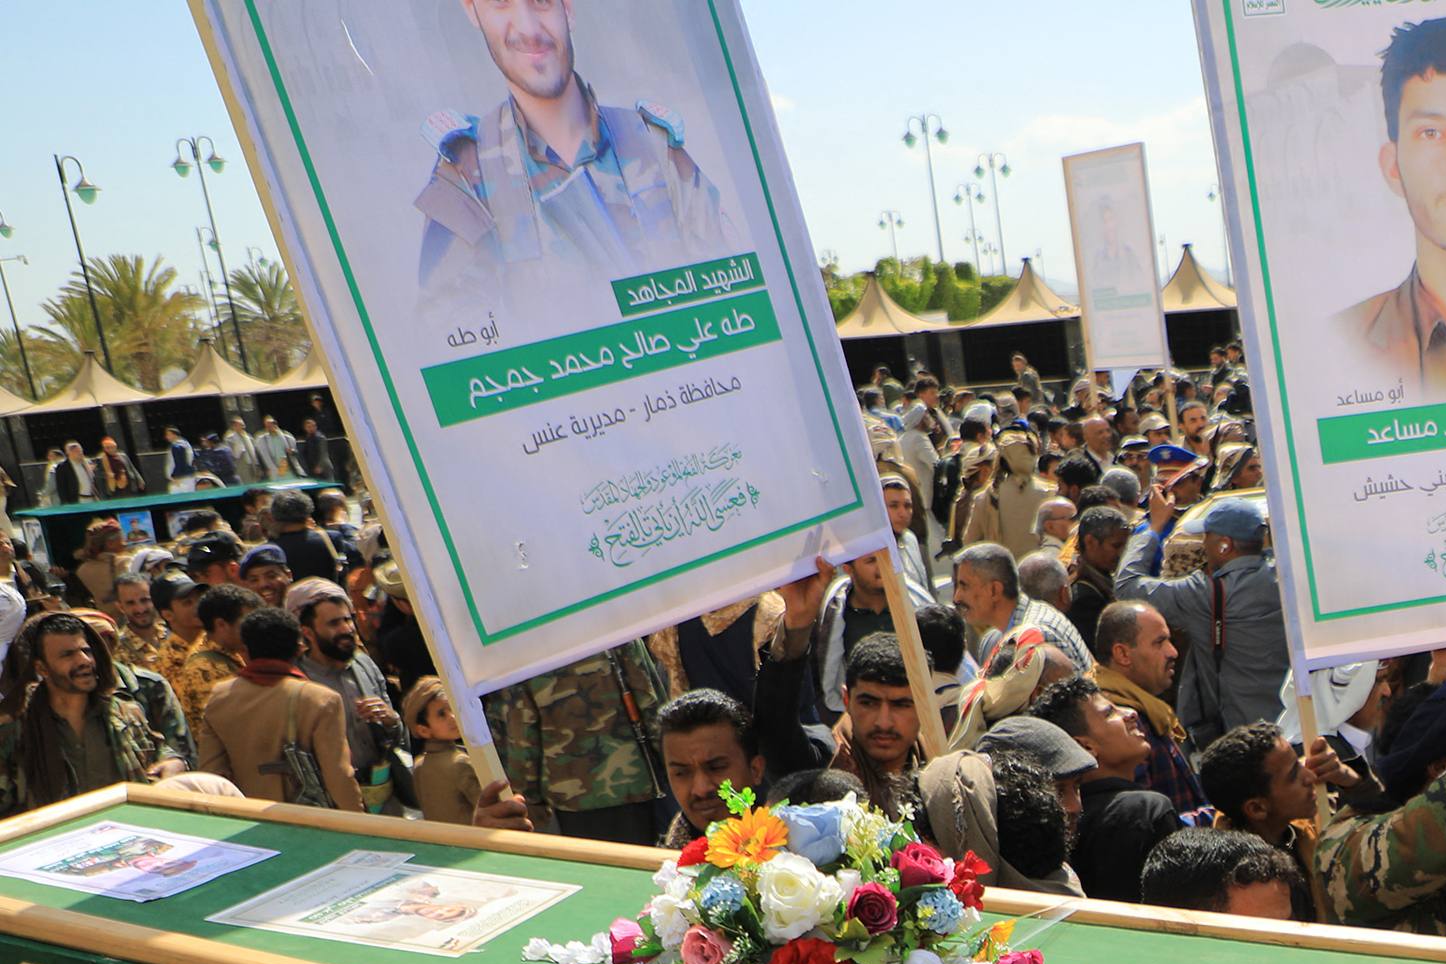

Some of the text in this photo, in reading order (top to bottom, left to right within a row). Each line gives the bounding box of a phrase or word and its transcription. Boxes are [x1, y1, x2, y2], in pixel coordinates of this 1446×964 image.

[627, 258, 754, 306] الشهيد المجاهد
[447, 311, 500, 348] أبو طه
[469, 308, 756, 409] طه علي صالح محمد جمجم
[643, 390, 677, 422] ذمار
[679, 376, 742, 405] محافظة
[1336, 378, 1404, 407] أبو مساعد
[522, 422, 568, 455] عنس
[570, 407, 626, 440] مديرية
[1367, 419, 1438, 445] مساعد
[1354, 474, 1415, 502] حشيش
